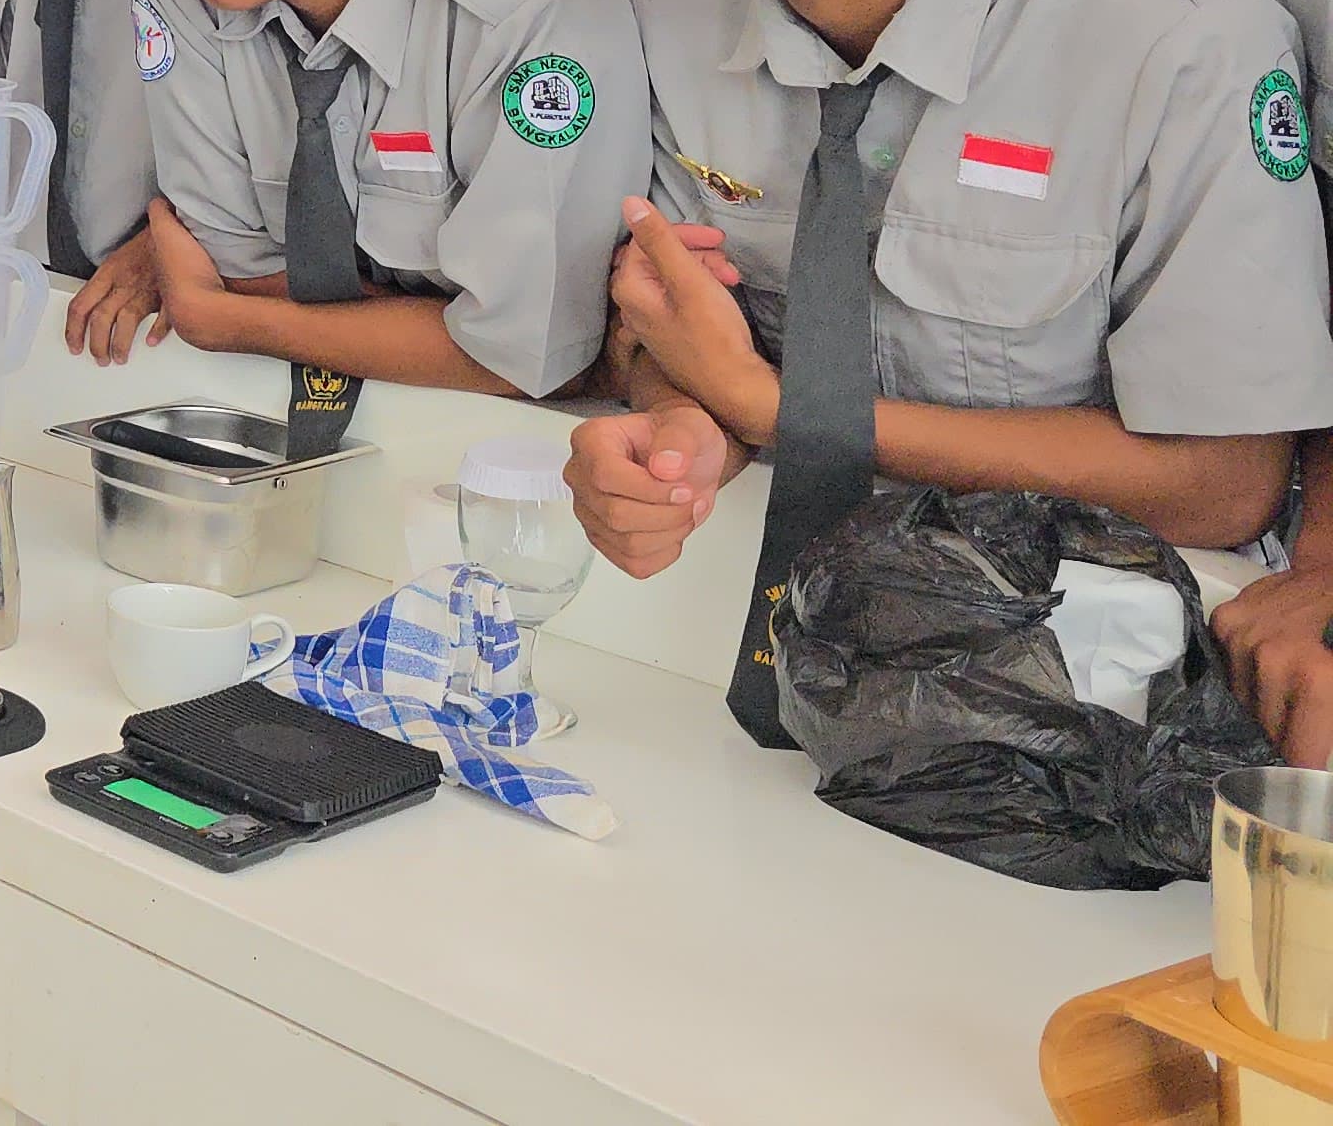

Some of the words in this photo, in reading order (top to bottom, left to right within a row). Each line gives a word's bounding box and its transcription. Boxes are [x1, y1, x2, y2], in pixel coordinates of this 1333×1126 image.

[507, 64, 536, 94] SMK
[540, 58, 589, 89] NEGERI
[507, 108, 589, 146] BANGKALAN
